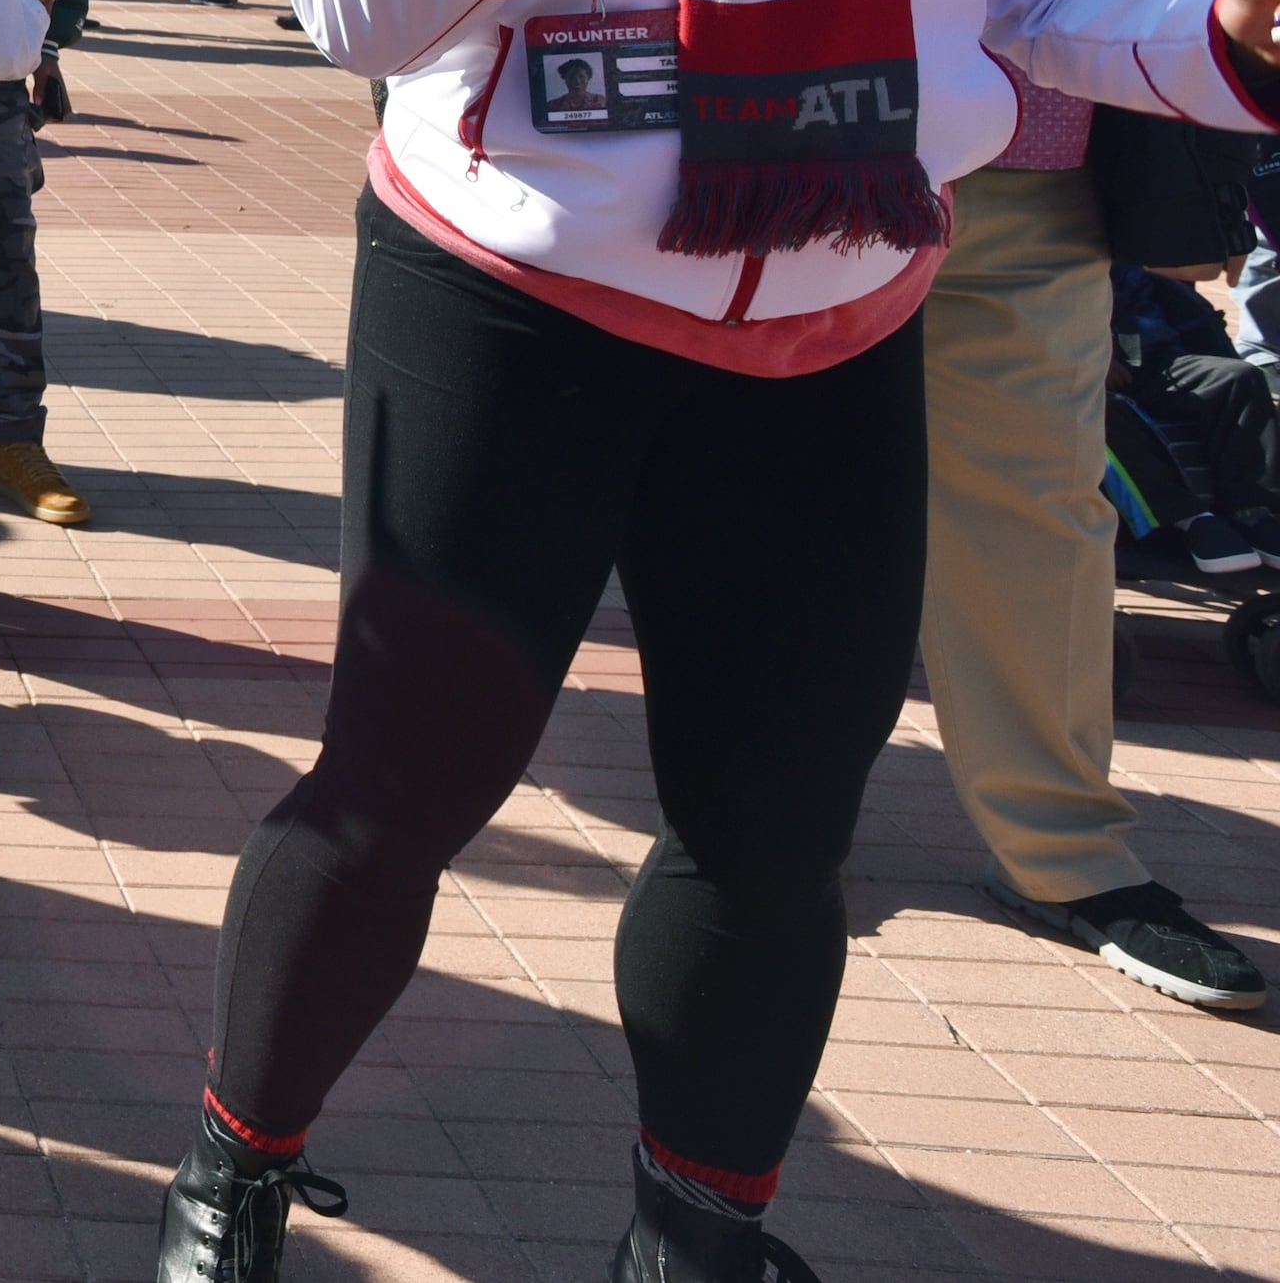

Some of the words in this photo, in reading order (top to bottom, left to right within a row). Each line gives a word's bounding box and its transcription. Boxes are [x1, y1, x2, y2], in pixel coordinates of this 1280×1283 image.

[543, 27, 649, 45] VOLUNTEER
[693, 95, 798, 123] TEAM
[792, 76, 913, 131] ATL
